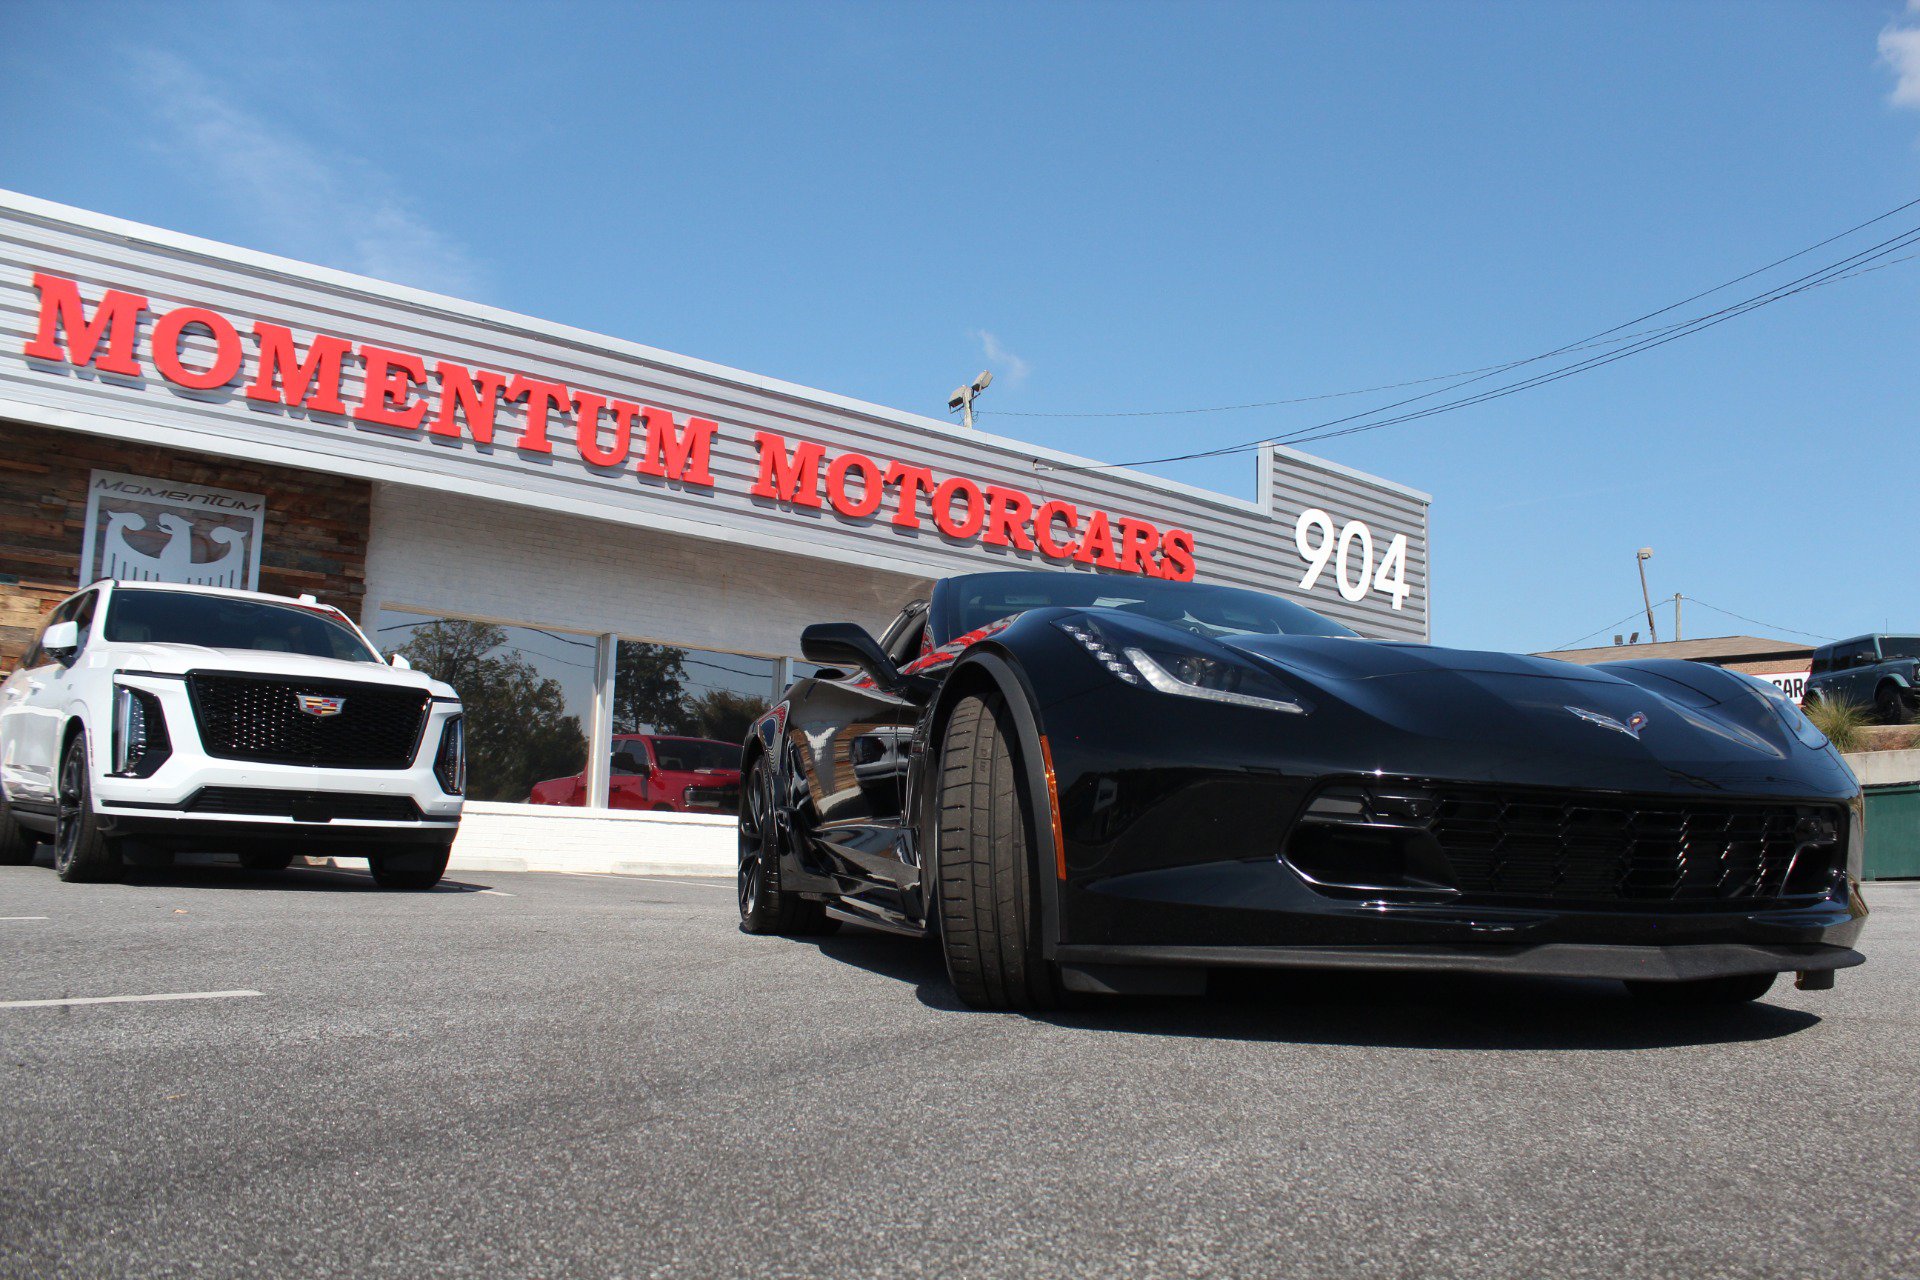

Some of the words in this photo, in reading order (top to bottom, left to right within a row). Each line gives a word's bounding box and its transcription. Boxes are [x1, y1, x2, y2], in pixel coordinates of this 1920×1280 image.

[23, 271, 719, 488] MOMENTUM
[750, 431, 1196, 583] MOTORCARS
[1295, 508, 1411, 611] 904
